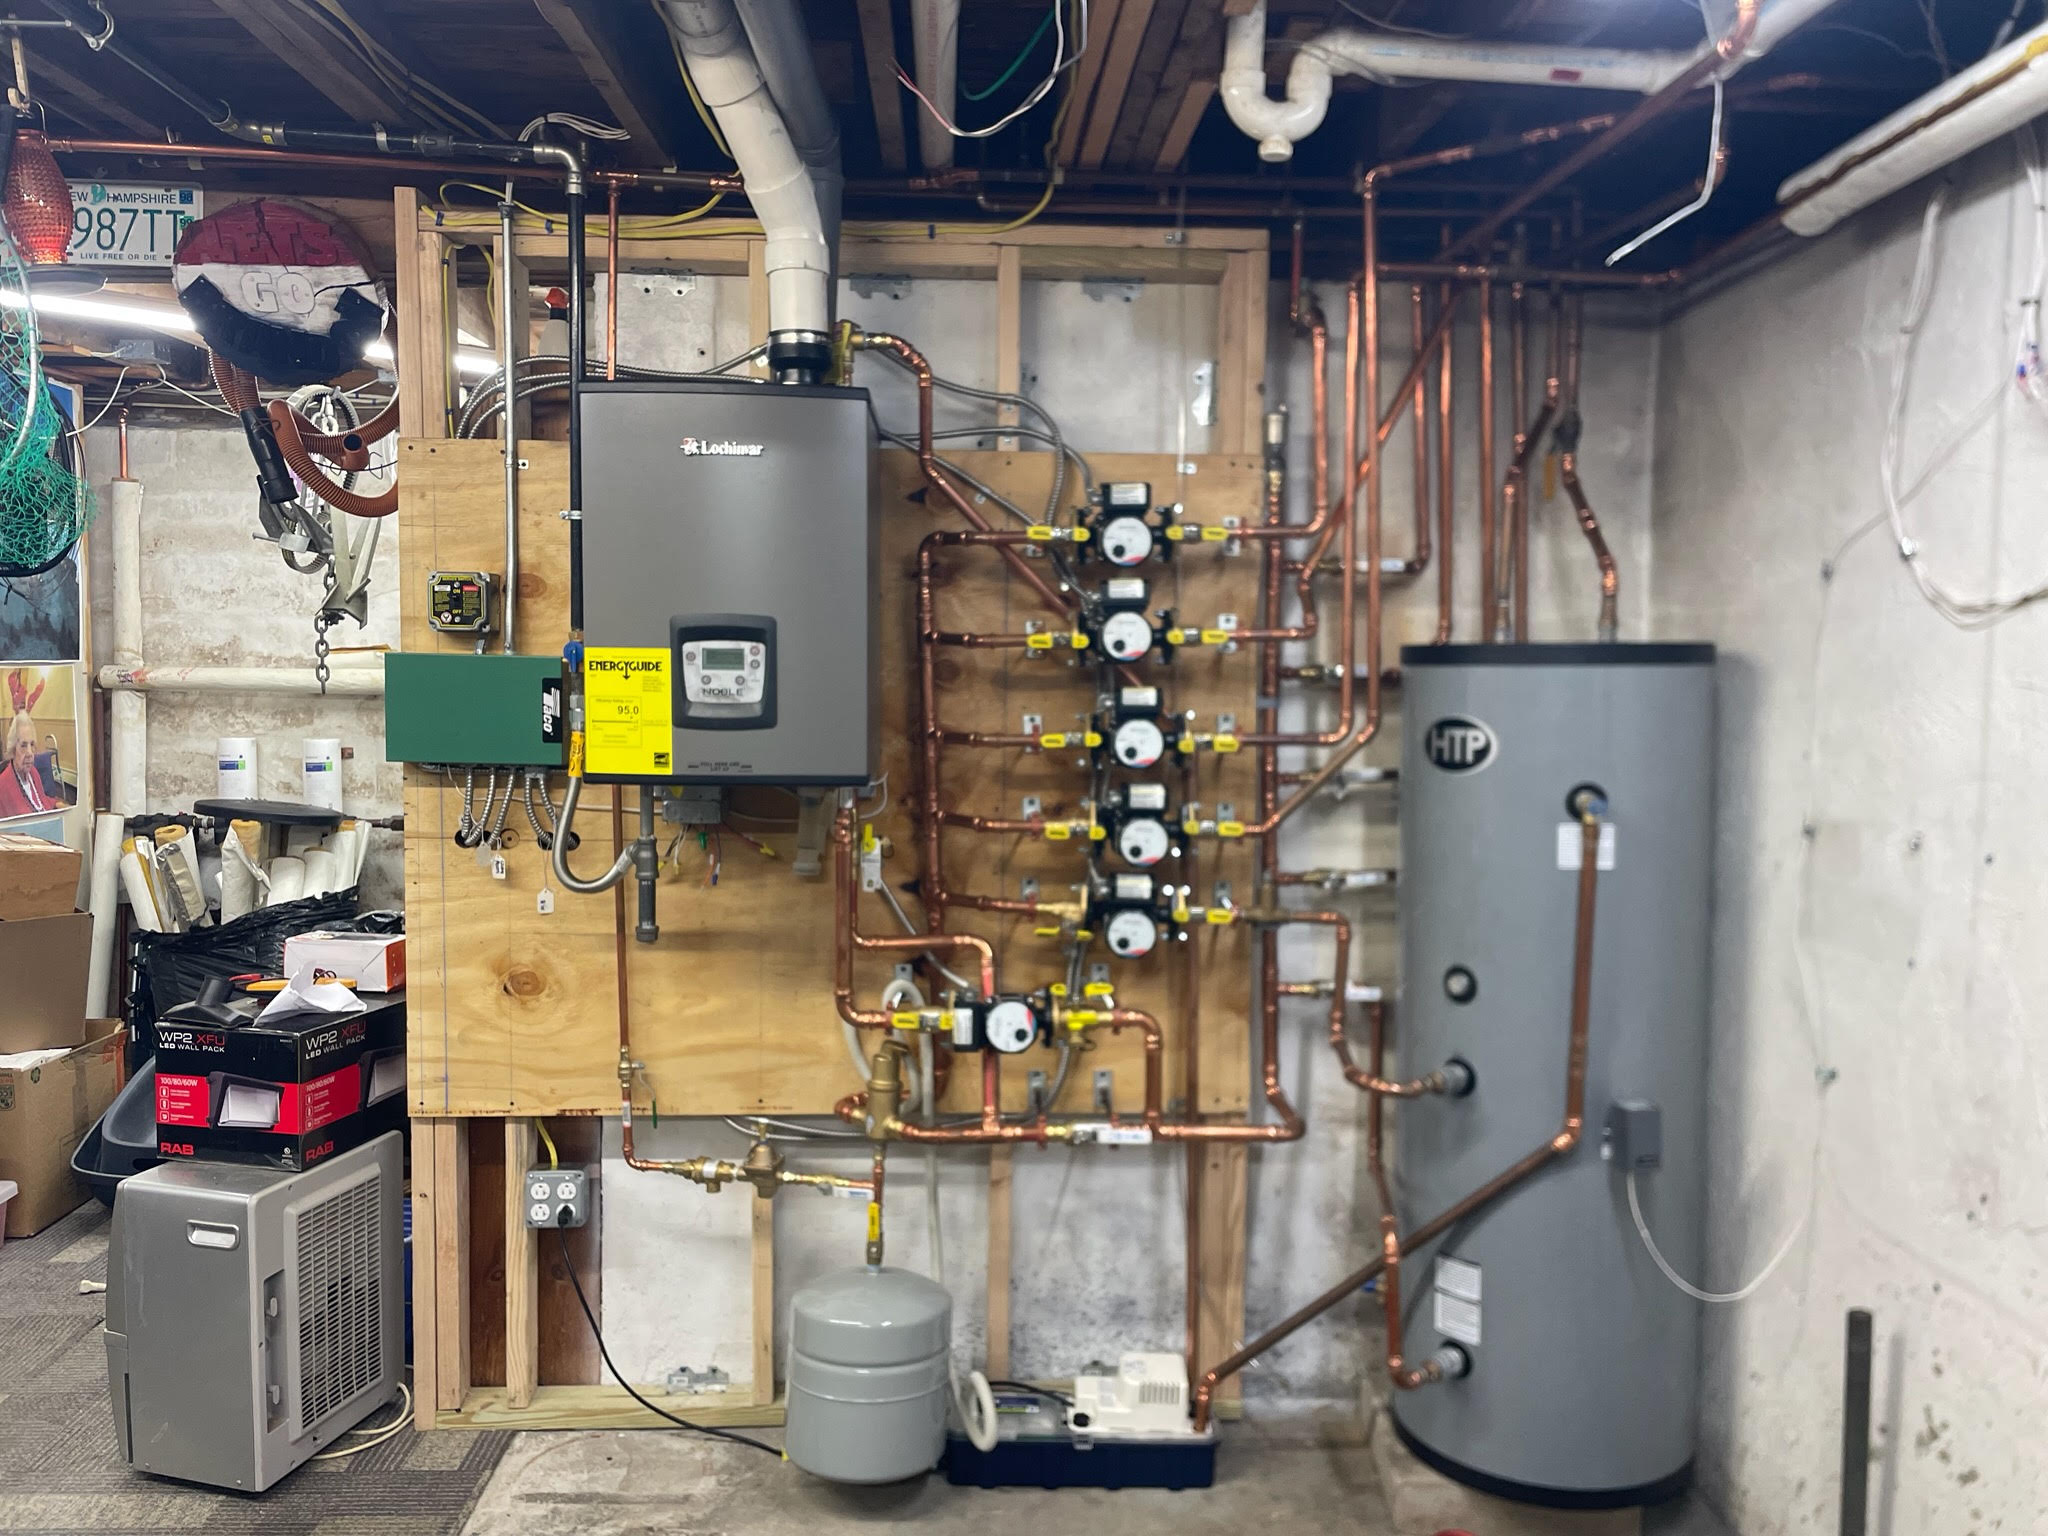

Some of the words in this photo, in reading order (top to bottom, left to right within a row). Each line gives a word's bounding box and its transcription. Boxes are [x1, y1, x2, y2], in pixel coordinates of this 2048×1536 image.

[70, 192, 88, 201] EW
[107, 193, 177, 204] HAMPSHIRE
[73, 207, 185, 252] 987TT
[241, 271, 316, 314] GO
[589, 661, 662, 672] ENERGYGUIDE
[617, 705, 639, 715] 95.0
[1431, 728, 1486, 764] HTP
[160, 1032, 192, 1043] WP2
[196, 1034, 225, 1045] XFU
[305, 1031, 338, 1050] WP2
[341, 1020, 367, 1038] XFU
[202, 1045, 225, 1053] PACK
[305, 1049, 322, 1060] LED
[323, 1043, 344, 1054] WALL
[346, 1034, 366, 1046] PACK
[161, 1142, 194, 1156] RAB
[306, 1141, 334, 1162] RAB
